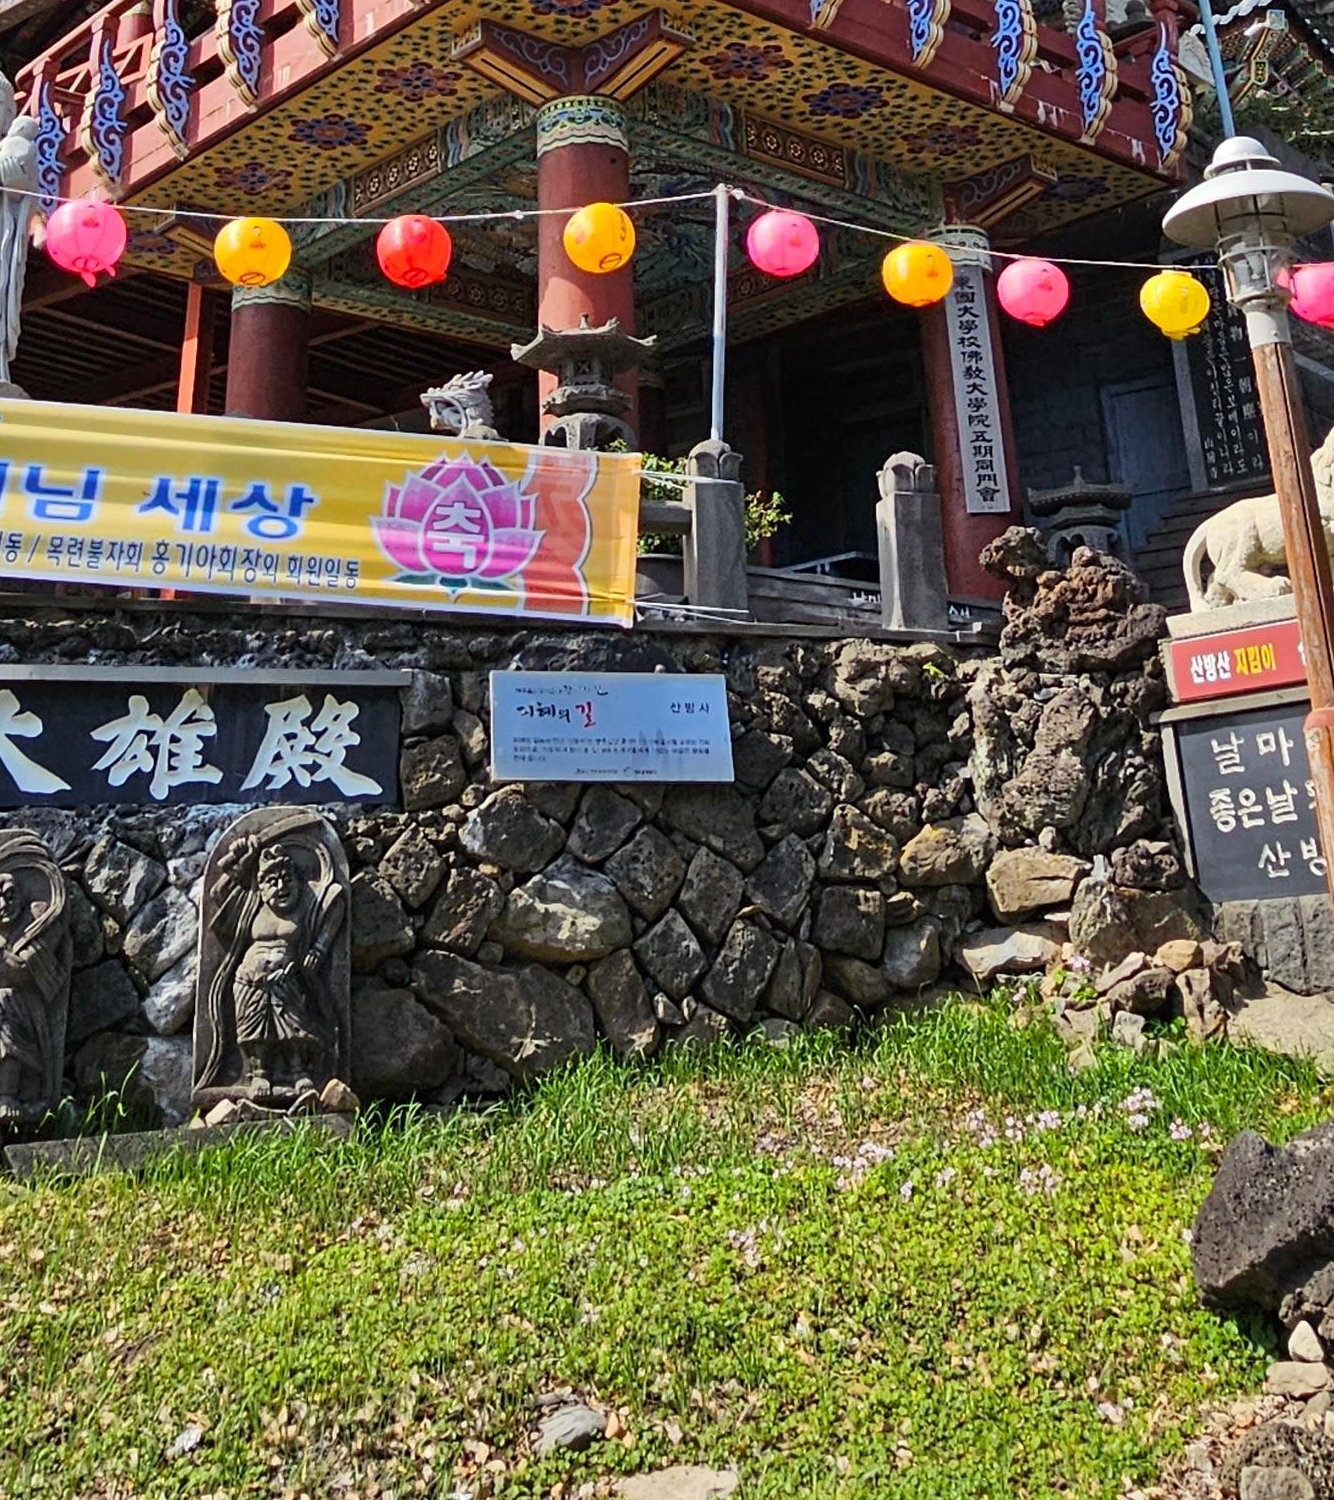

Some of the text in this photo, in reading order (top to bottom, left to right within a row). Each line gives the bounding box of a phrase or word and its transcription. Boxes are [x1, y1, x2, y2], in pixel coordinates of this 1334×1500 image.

[138, 477, 314, 539] 세상
[426, 501, 486, 569] 축
[46, 535, 144, 574] 목련불자회
[286, 551, 360, 590] 회원일동
[1190, 652, 1232, 685] 산방산
[574, 700, 596, 729] 길
[1210, 726, 1295, 775] 날마
[1258, 836, 1328, 878] 산방
